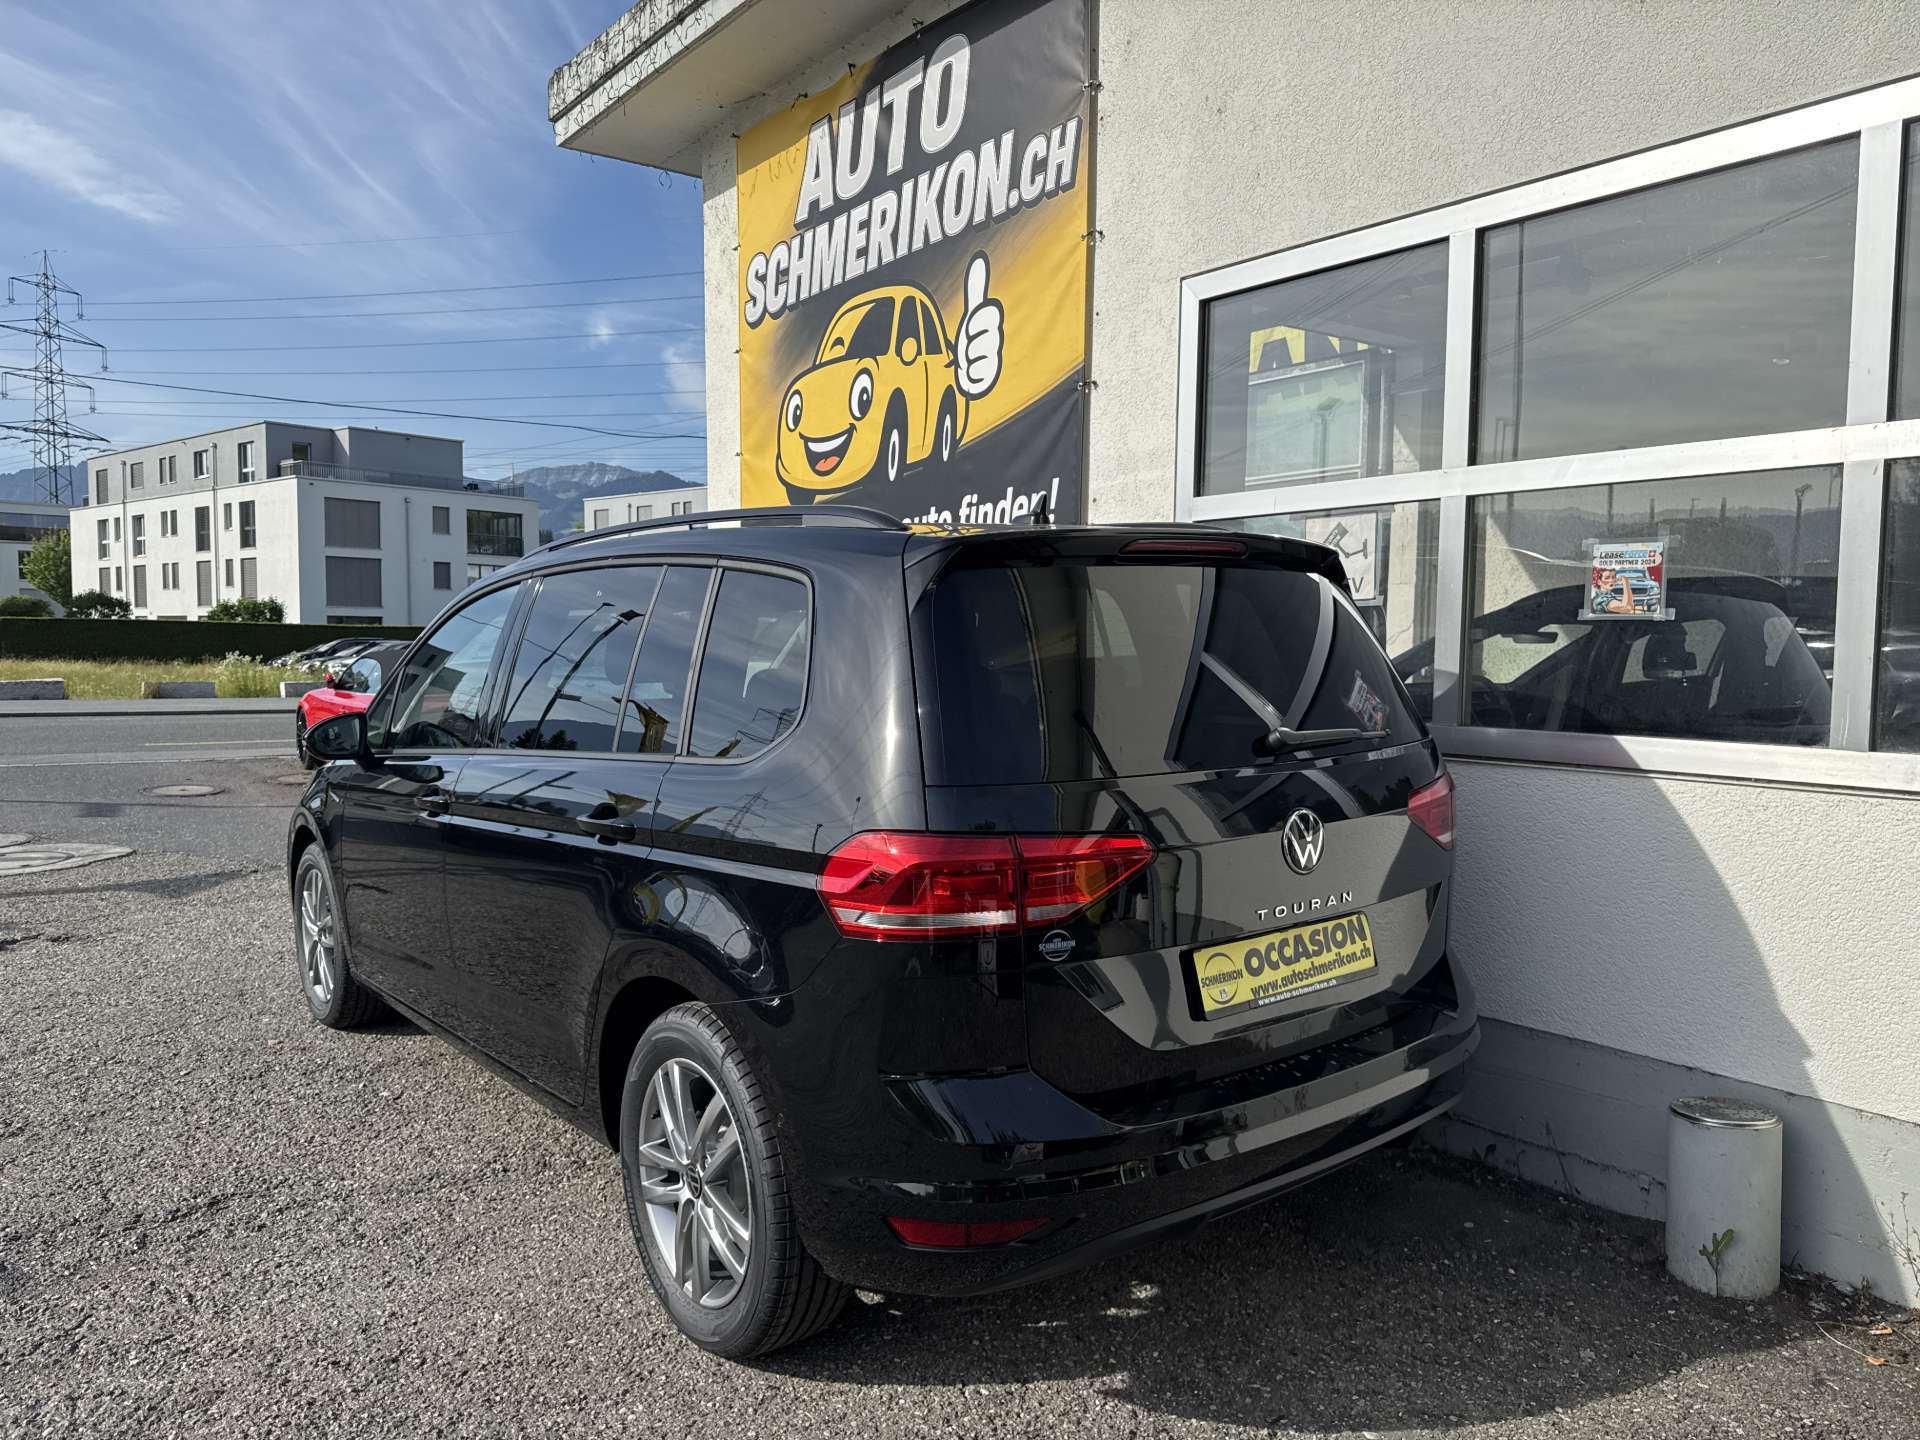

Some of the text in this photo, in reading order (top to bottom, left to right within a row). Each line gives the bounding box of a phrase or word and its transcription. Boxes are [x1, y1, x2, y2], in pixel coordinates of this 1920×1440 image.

[795, 33, 971, 225] AUTO
[744, 116, 1082, 325] SCHMERIKON.CH
[1257, 891, 1353, 921] TOURAN
[1243, 915, 1368, 977] OCCASION
[1250, 943, 1372, 998] www.autoschmerikon.ch
[1200, 969, 1244, 988] SCHMERIKON
